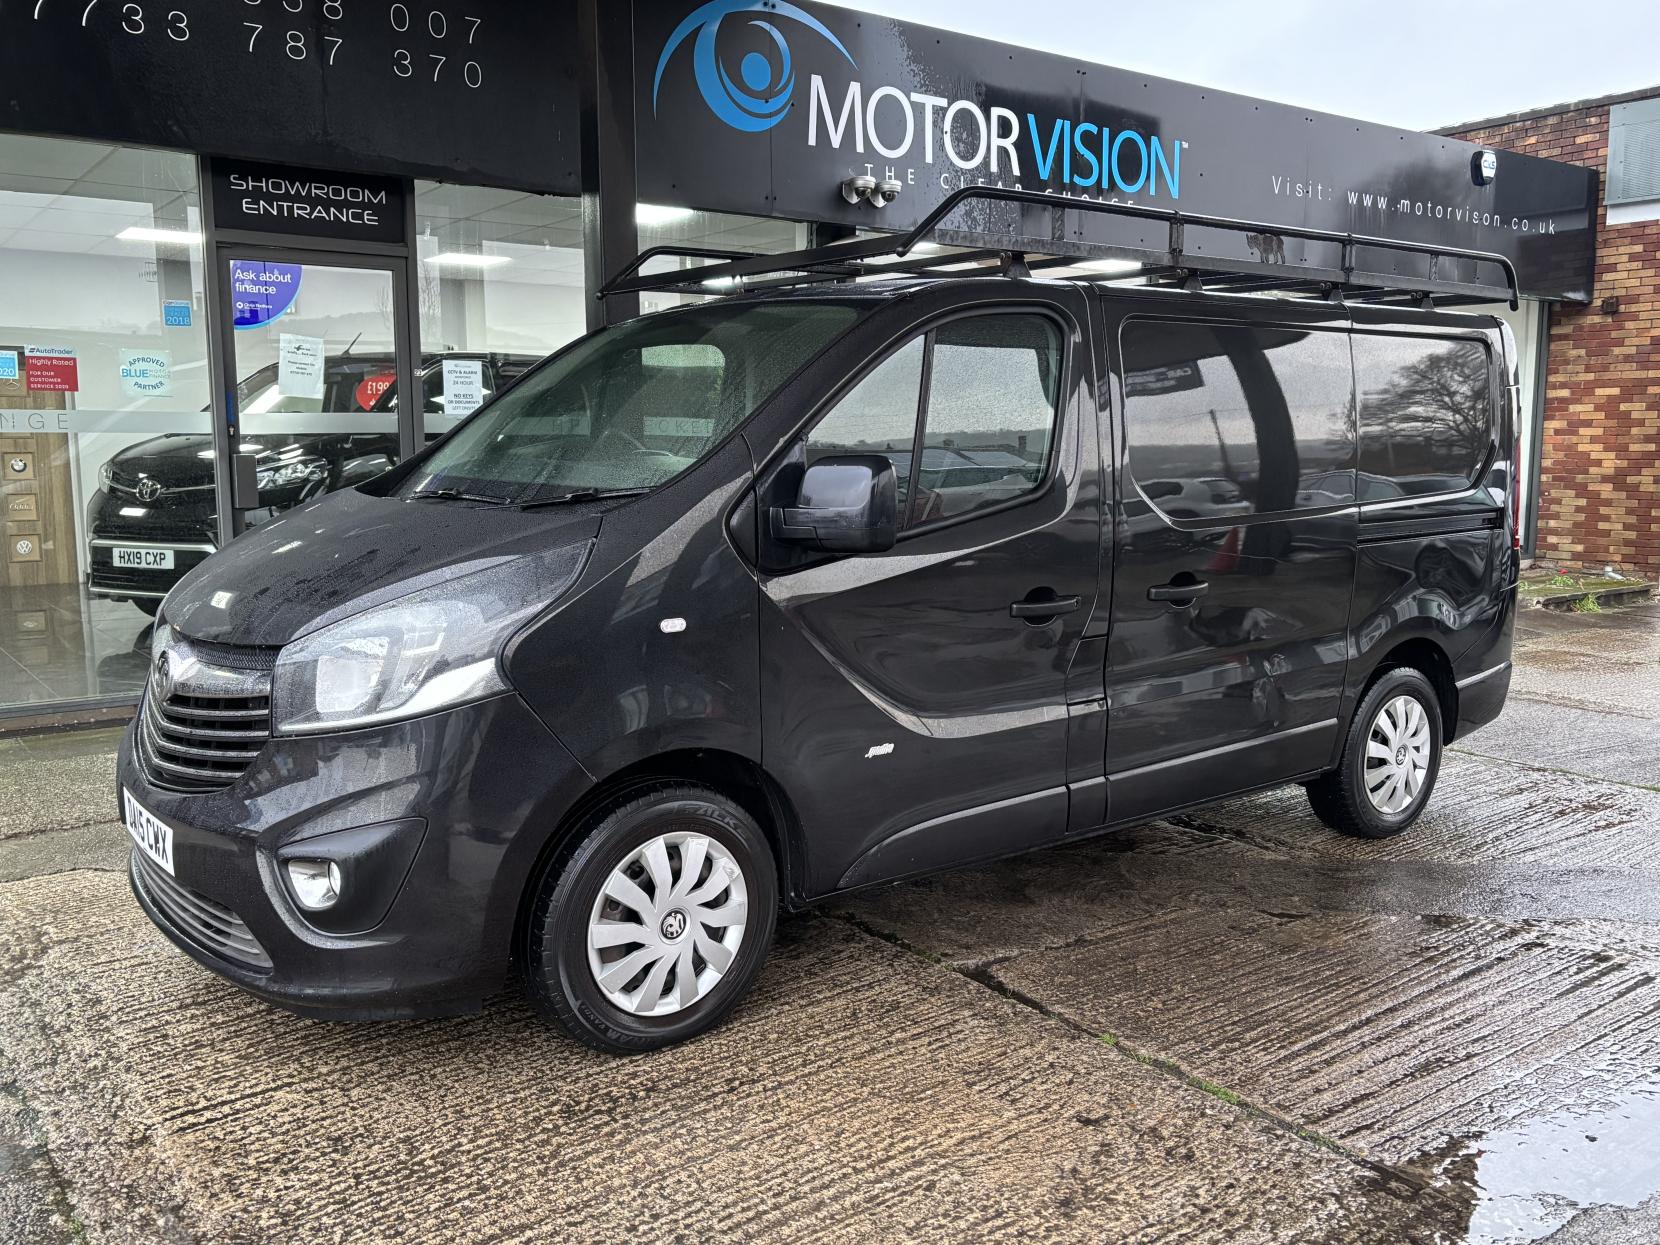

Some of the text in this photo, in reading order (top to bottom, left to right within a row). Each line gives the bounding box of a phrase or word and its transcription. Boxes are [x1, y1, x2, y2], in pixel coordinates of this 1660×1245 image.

[390, 3, 482, 45] 007
[243, 22, 343, 66] 787
[394, 49, 482, 88] 370
[806, 73, 1181, 200] MOTOR VISION
[864, 163, 915, 185] THE
[229, 174, 386, 205] SHOWROOM
[242, 198, 379, 225] ENTRANCE
[1272, 175, 1555, 235] Visit: www.motorvison.co.uk
[234, 269, 292, 283] Ask about
[235, 282, 277, 294] finance
[166, 316, 190, 325] 2018
[35, 347, 73, 355] AutoTrader
[29, 358, 52, 366] Highly
[128, 356, 165, 368] APPROVED
[121, 368, 149, 378] BLUE
[133, 380, 165, 391] PARTNER
[118, 550, 166, 566] HX19 CXP
